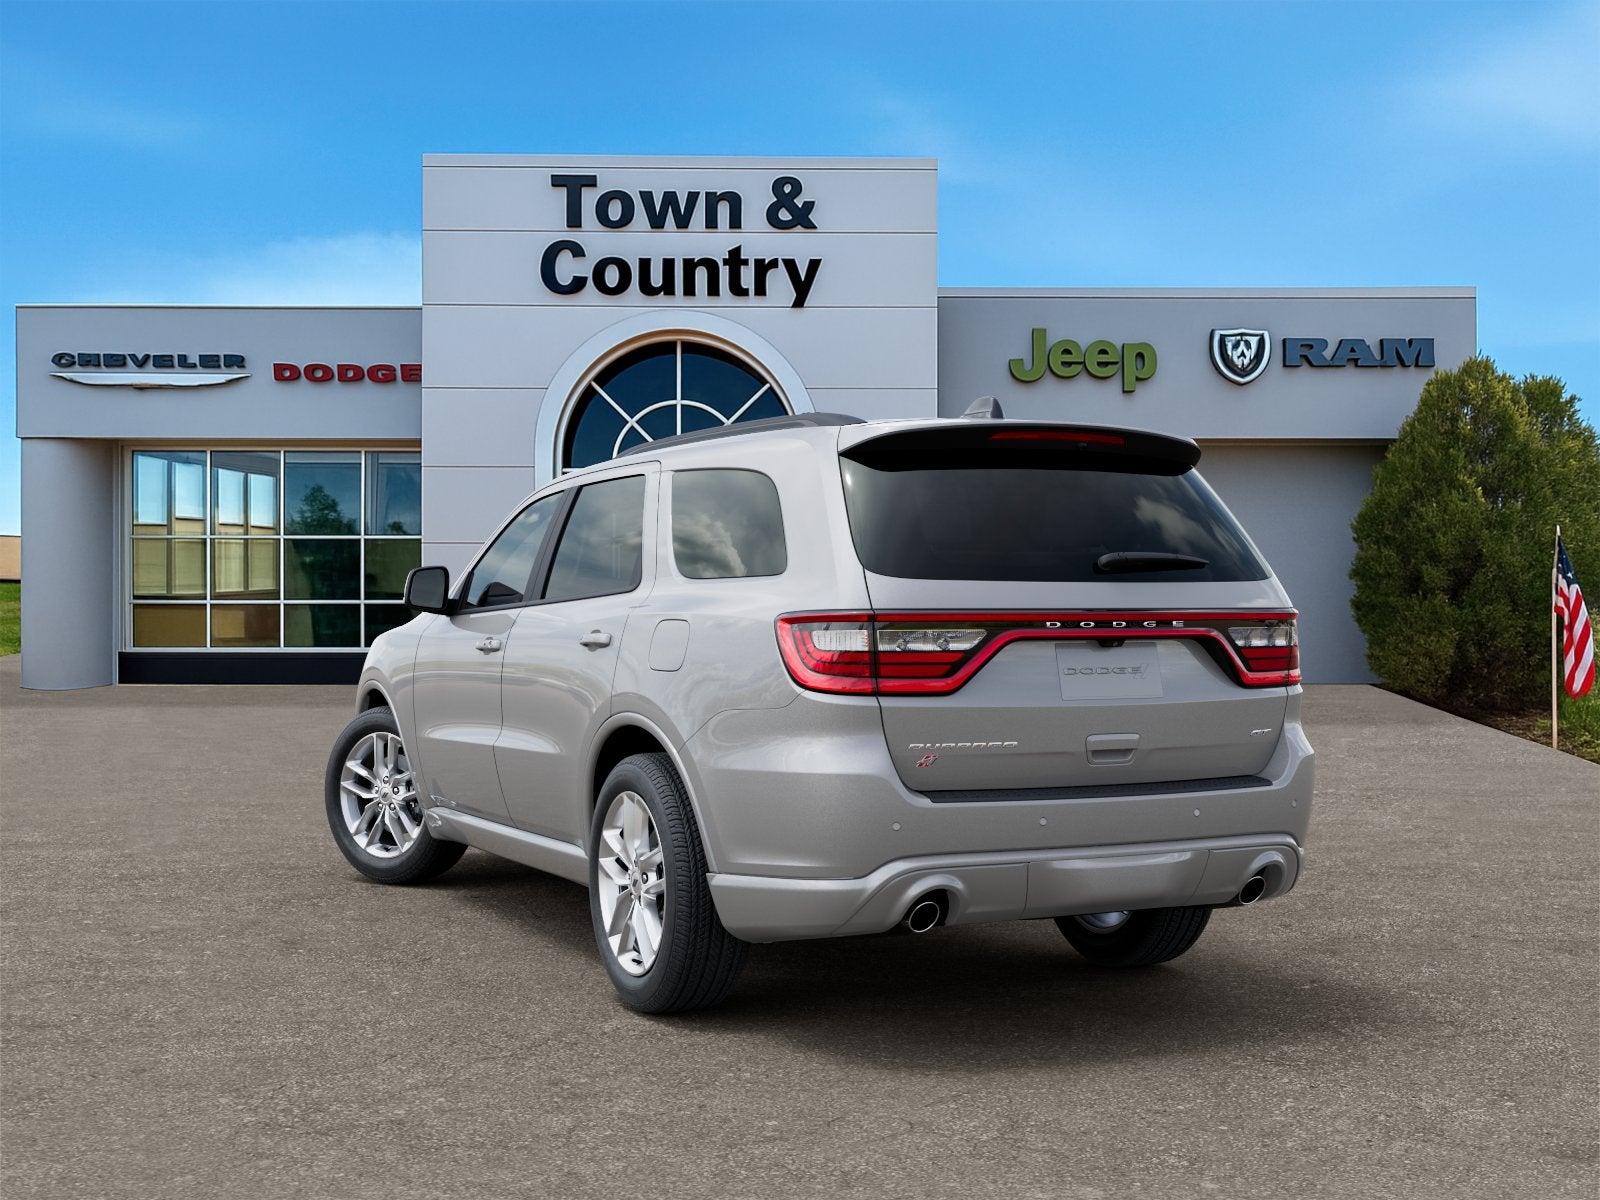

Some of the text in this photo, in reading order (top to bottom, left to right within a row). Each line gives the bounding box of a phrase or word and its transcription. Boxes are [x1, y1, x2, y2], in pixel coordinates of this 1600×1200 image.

[550, 174, 818, 230] Town &
[539, 239, 823, 308] Country
[1009, 327, 1158, 392] Jeep
[1282, 337, 1436, 368] RAM
[272, 363, 422, 383] DODGE
[1045, 620, 1185, 628] DODGE
[1063, 666, 1144, 676] DODGE
